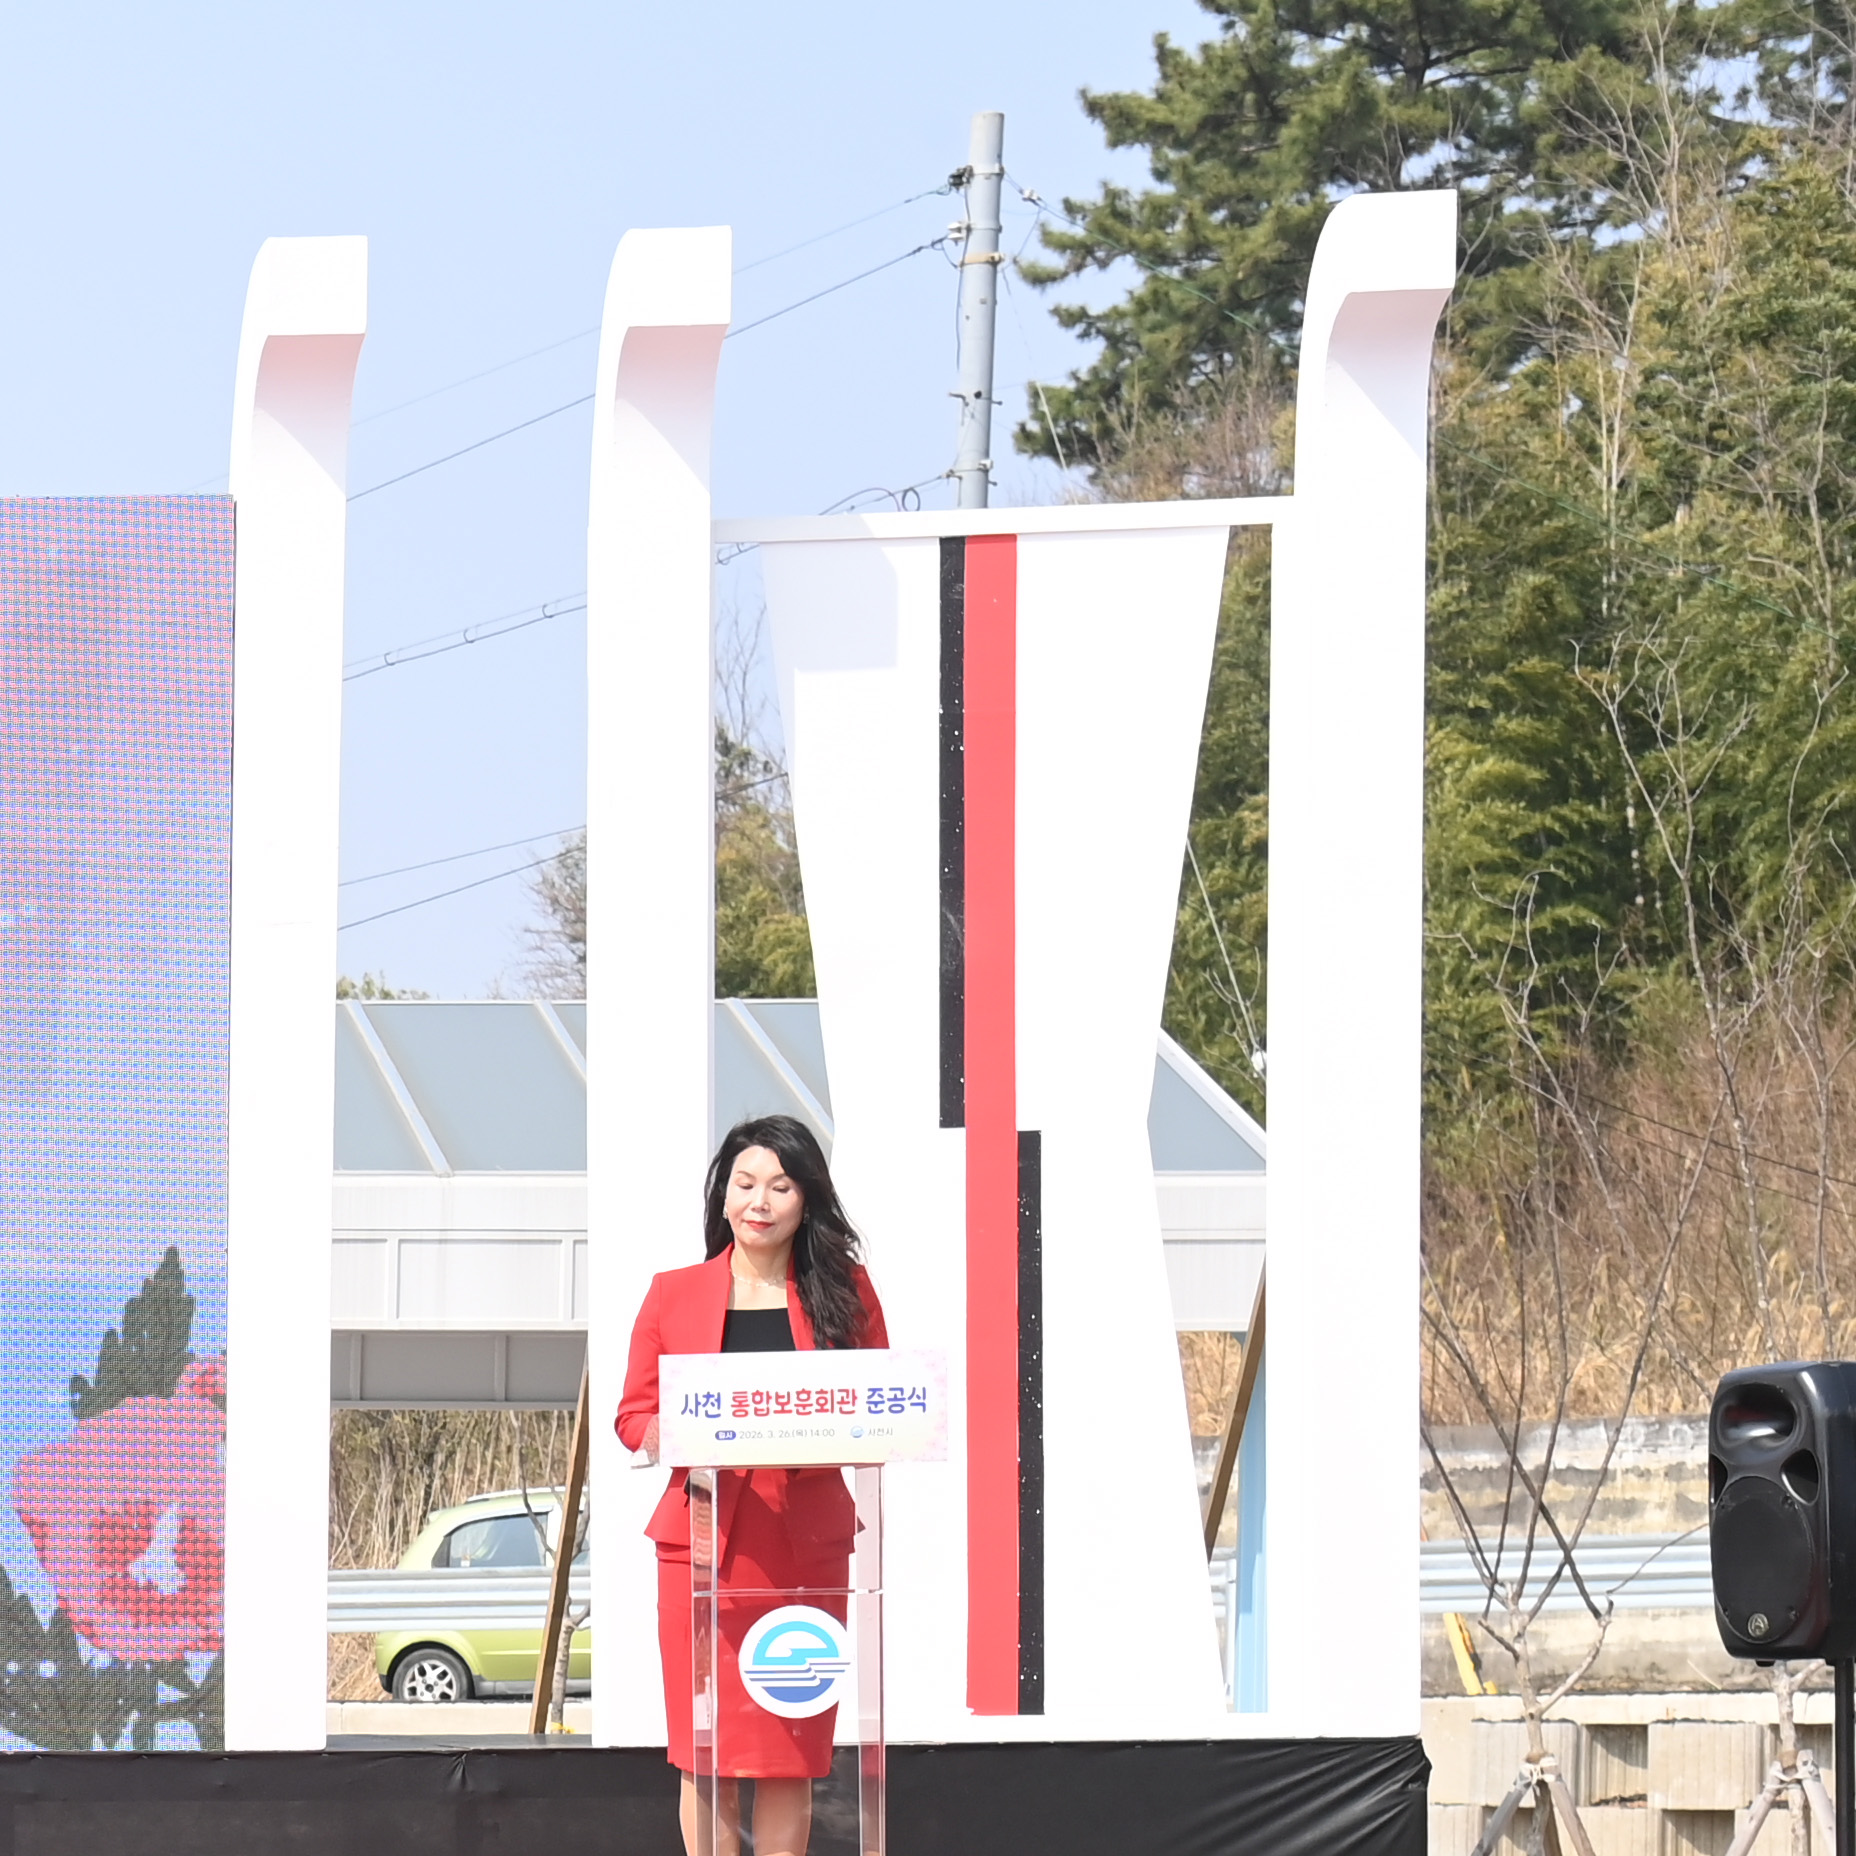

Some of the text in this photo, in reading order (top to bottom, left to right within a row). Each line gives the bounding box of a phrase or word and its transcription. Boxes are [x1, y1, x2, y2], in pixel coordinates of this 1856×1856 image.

[681, 1386, 927, 1418] 사천 통합보훈회관 준공식
